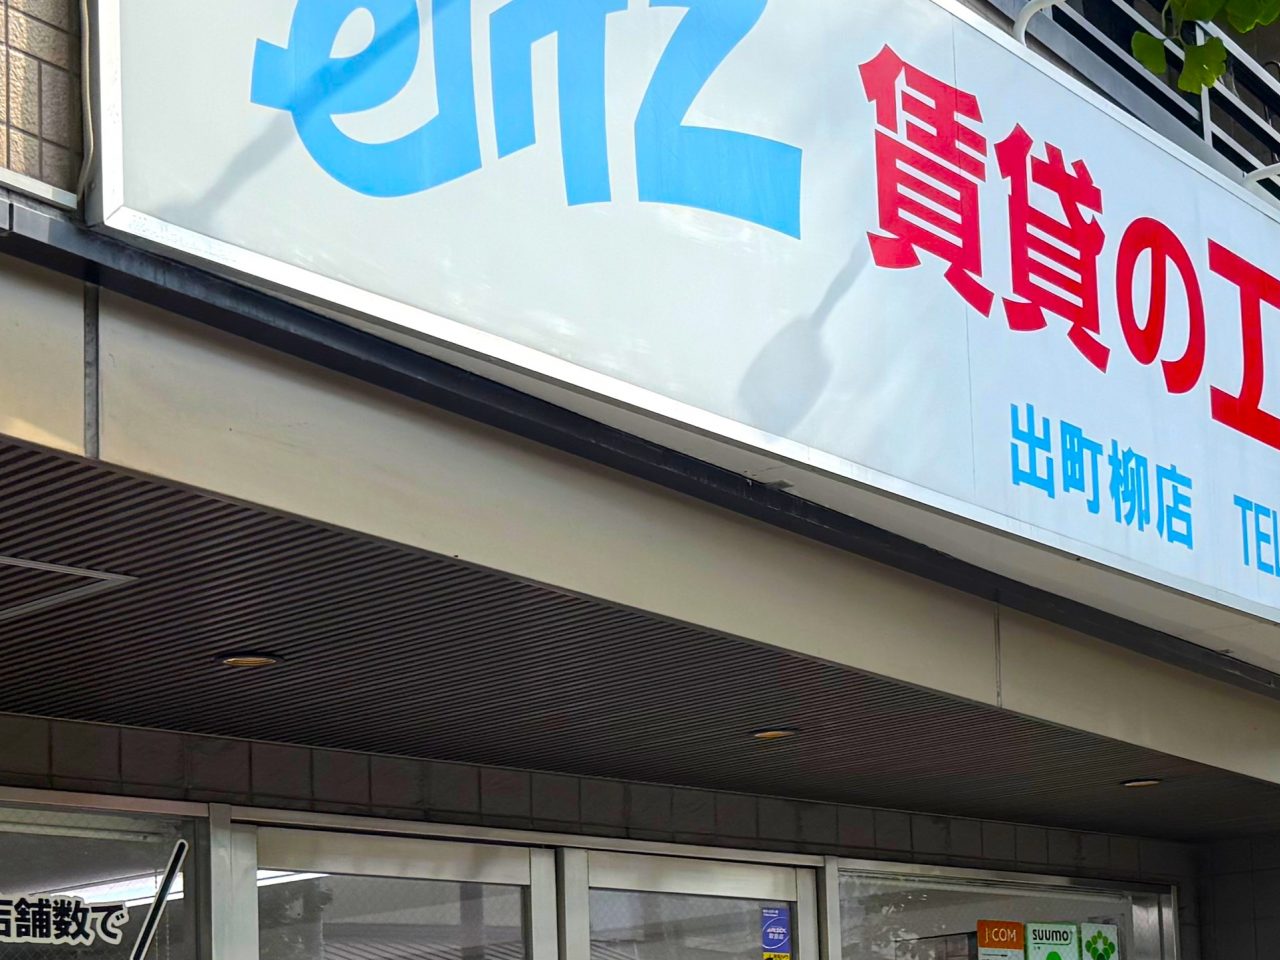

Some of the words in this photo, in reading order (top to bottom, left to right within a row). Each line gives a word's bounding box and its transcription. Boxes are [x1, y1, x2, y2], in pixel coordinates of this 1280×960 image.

[1010, 402, 1194, 550] 出町柳店
[1032, 928, 1070, 942] SUUMO
